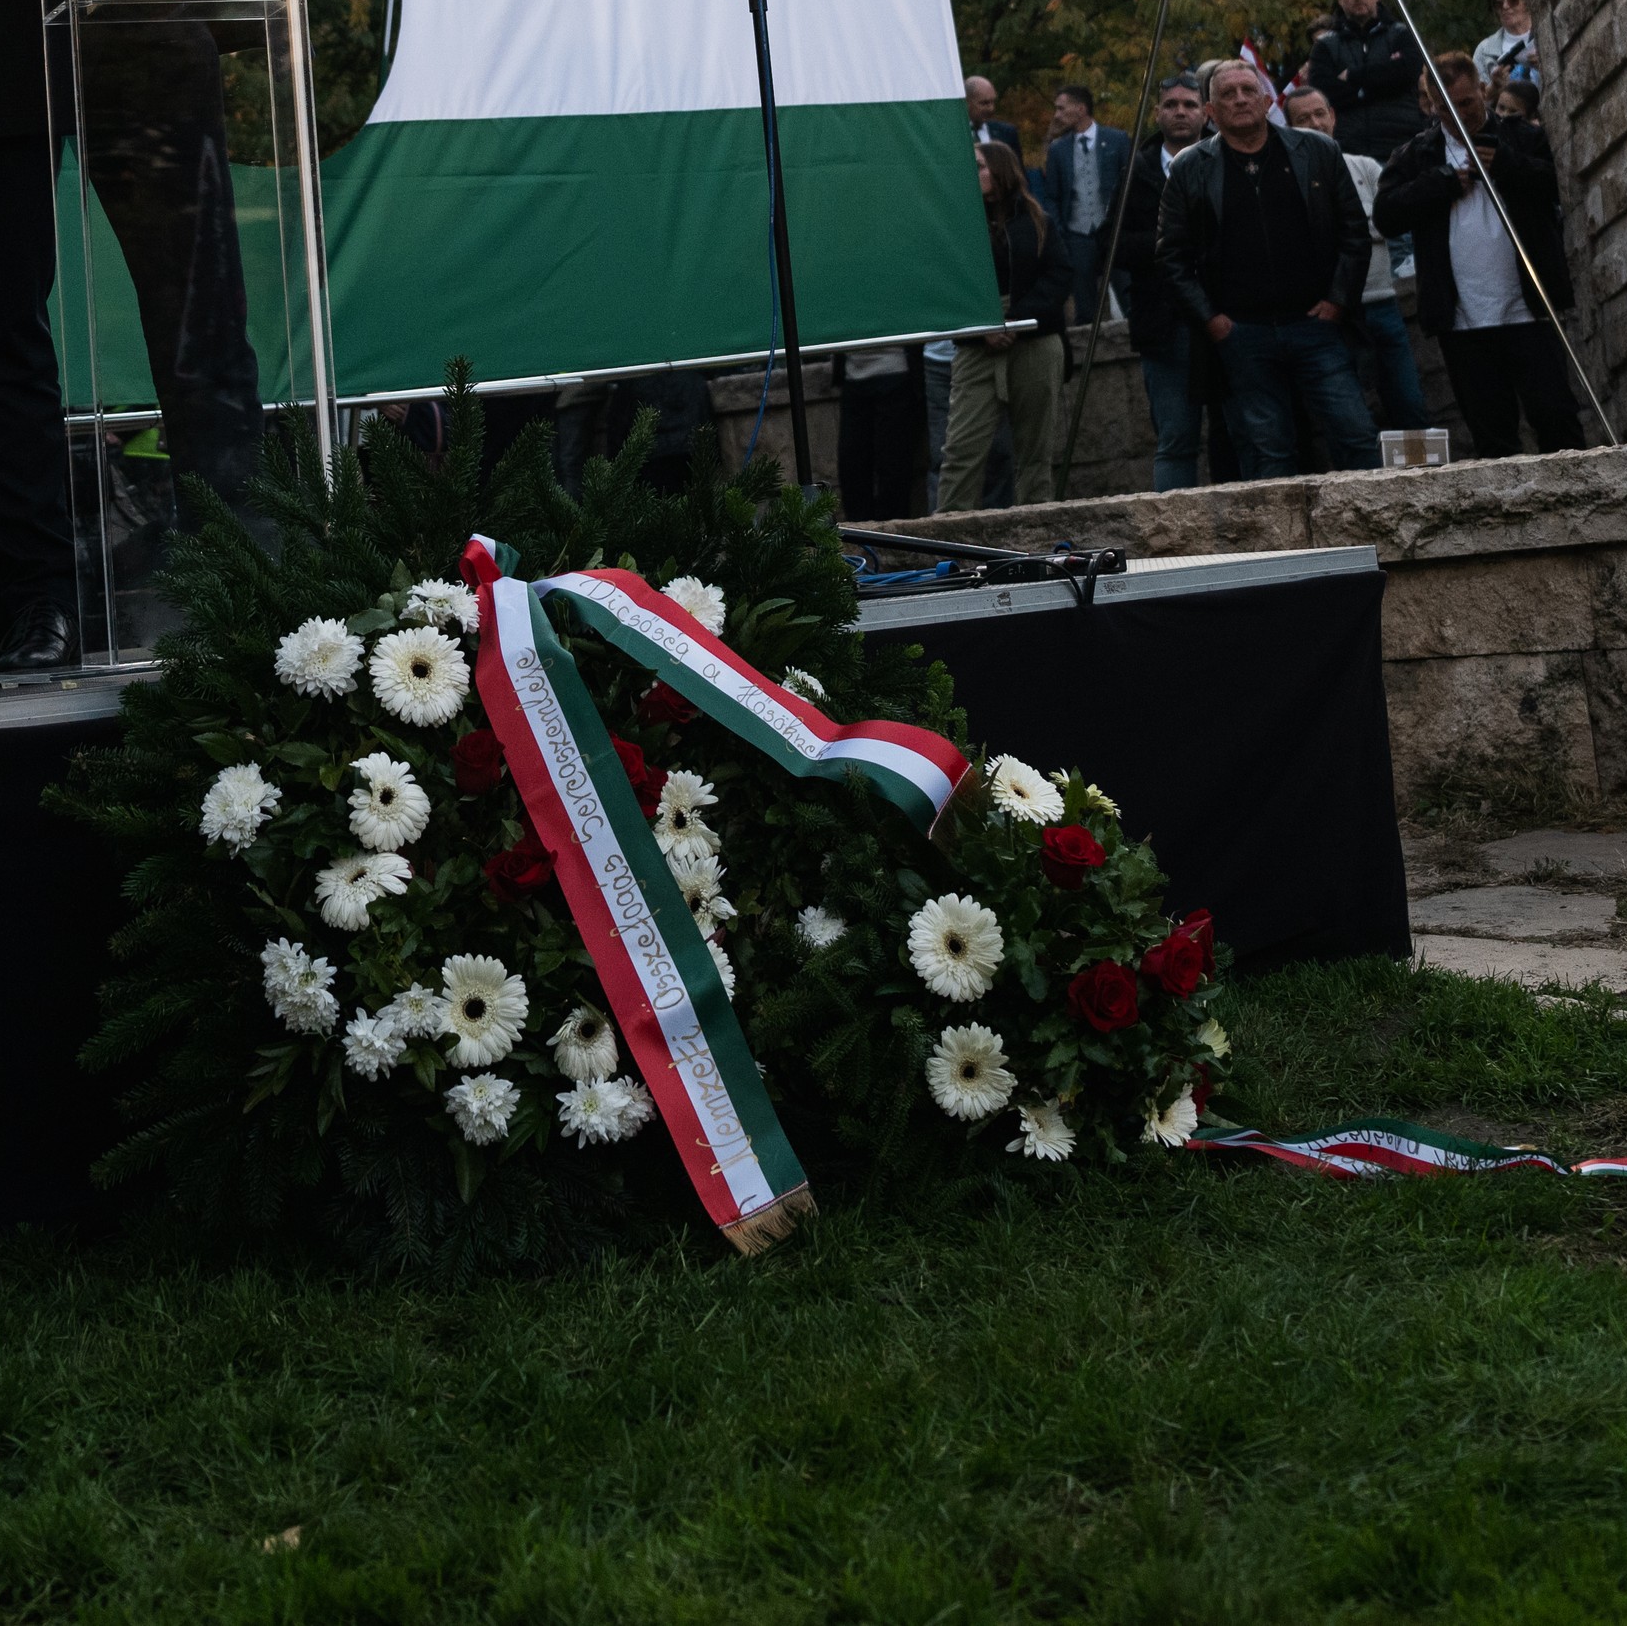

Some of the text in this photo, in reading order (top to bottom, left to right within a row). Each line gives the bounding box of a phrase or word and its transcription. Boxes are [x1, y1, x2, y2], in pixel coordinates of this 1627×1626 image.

[579, 578, 689, 664] Dicsőség
[702, 663, 721, 684] a
[513, 647, 759, 1177] Nemzeti Összefogás Seregszemléje
